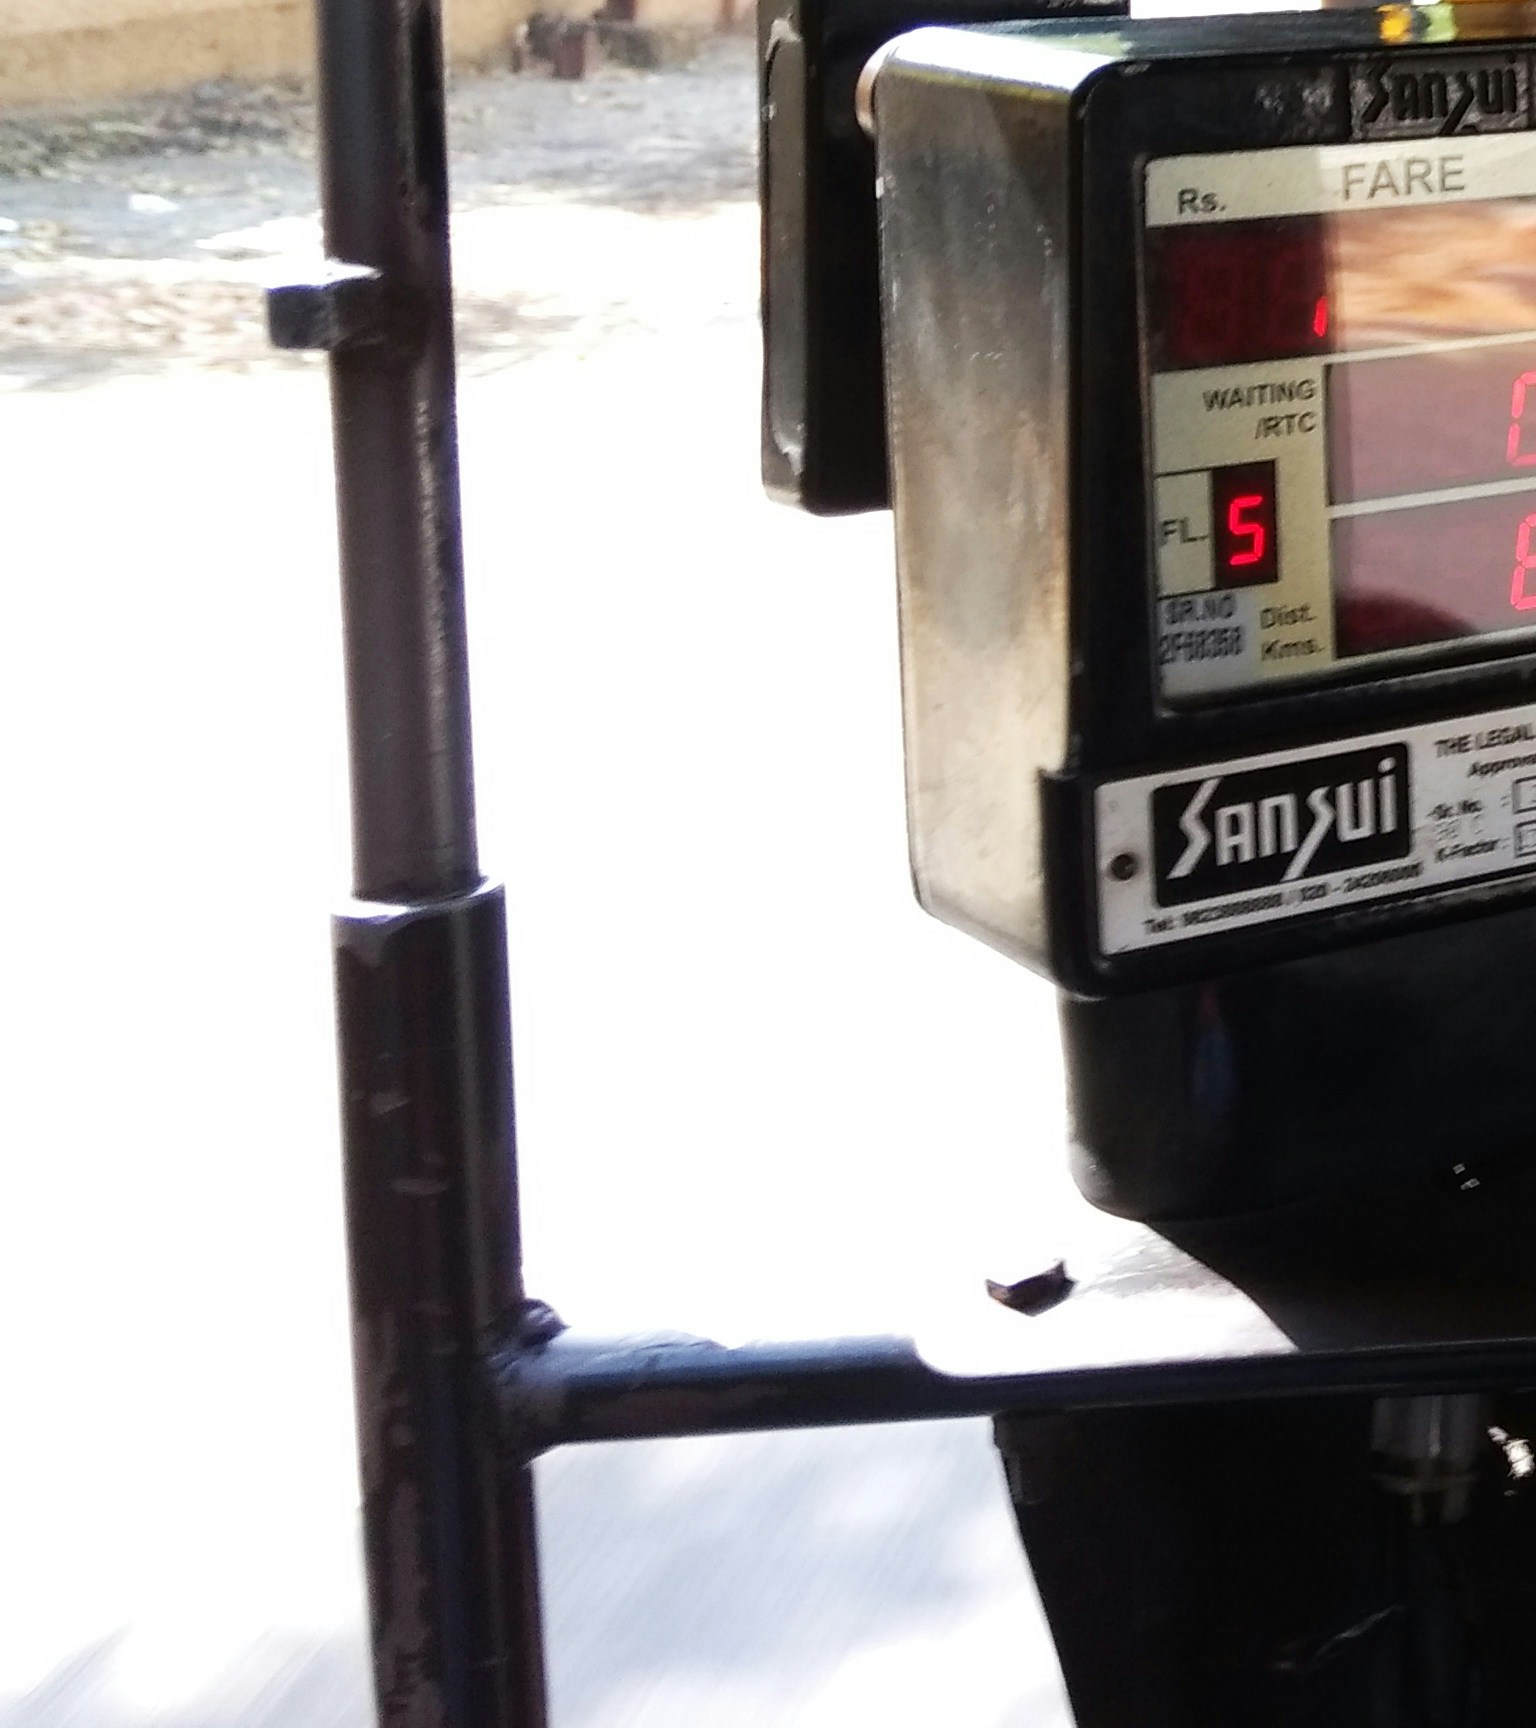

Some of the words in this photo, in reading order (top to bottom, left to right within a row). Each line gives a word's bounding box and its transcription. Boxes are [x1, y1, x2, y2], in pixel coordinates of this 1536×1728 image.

[1341, 154, 1466, 201] FARE
[1177, 188, 1227, 214] Rs.
[1203, 378, 1317, 412] WAITING
[1254, 411, 1317, 440] /RTC
[1261, 639, 1326, 662] Kms.
[1434, 733, 1471, 758] THE
[1474, 722, 1536, 750] LEGAL
[1167, 756, 1398, 884] Sansui
